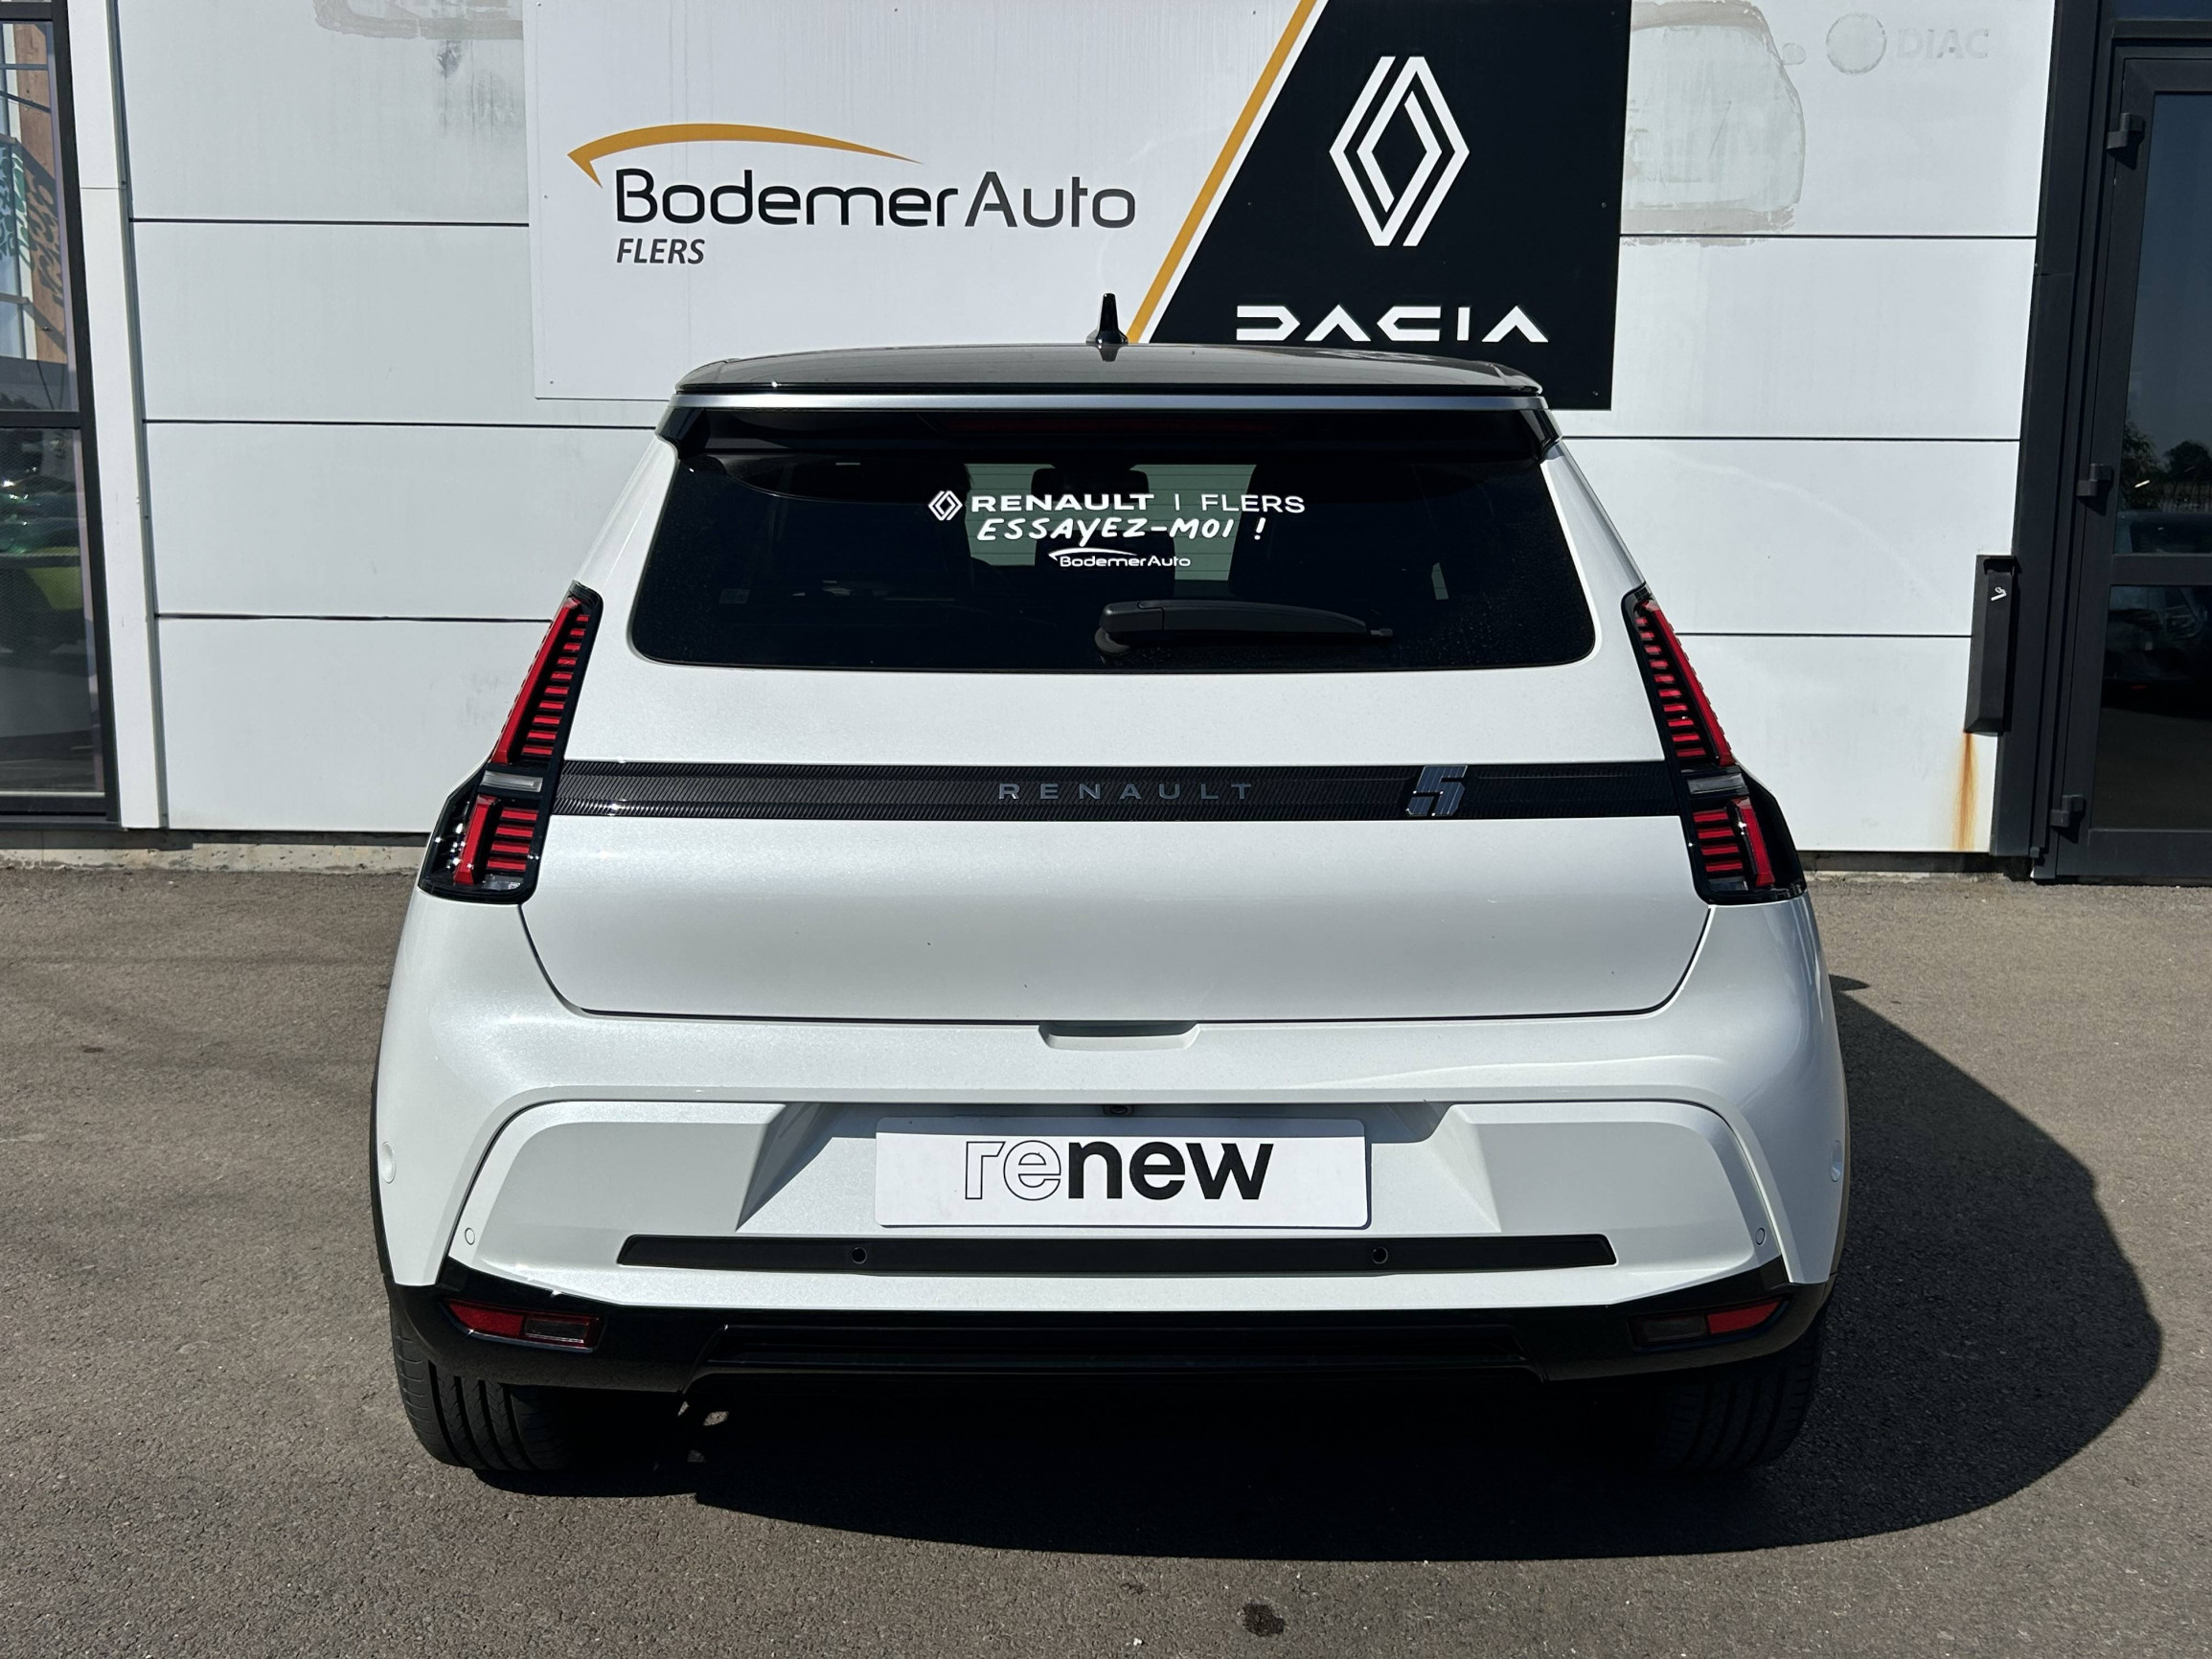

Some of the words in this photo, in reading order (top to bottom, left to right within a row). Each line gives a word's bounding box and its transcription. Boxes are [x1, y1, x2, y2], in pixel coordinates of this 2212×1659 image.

[617, 238, 705, 265] FLERS
[1236, 305, 1549, 343] DACIA
[971, 493, 1154, 512] RENAULT
[1200, 494, 1306, 513] FLERS
[976, 517, 1234, 547] ESSAYEZ-MOI
[998, 783, 1252, 800] RENAULT
[965, 1140, 1274, 1201] renew
